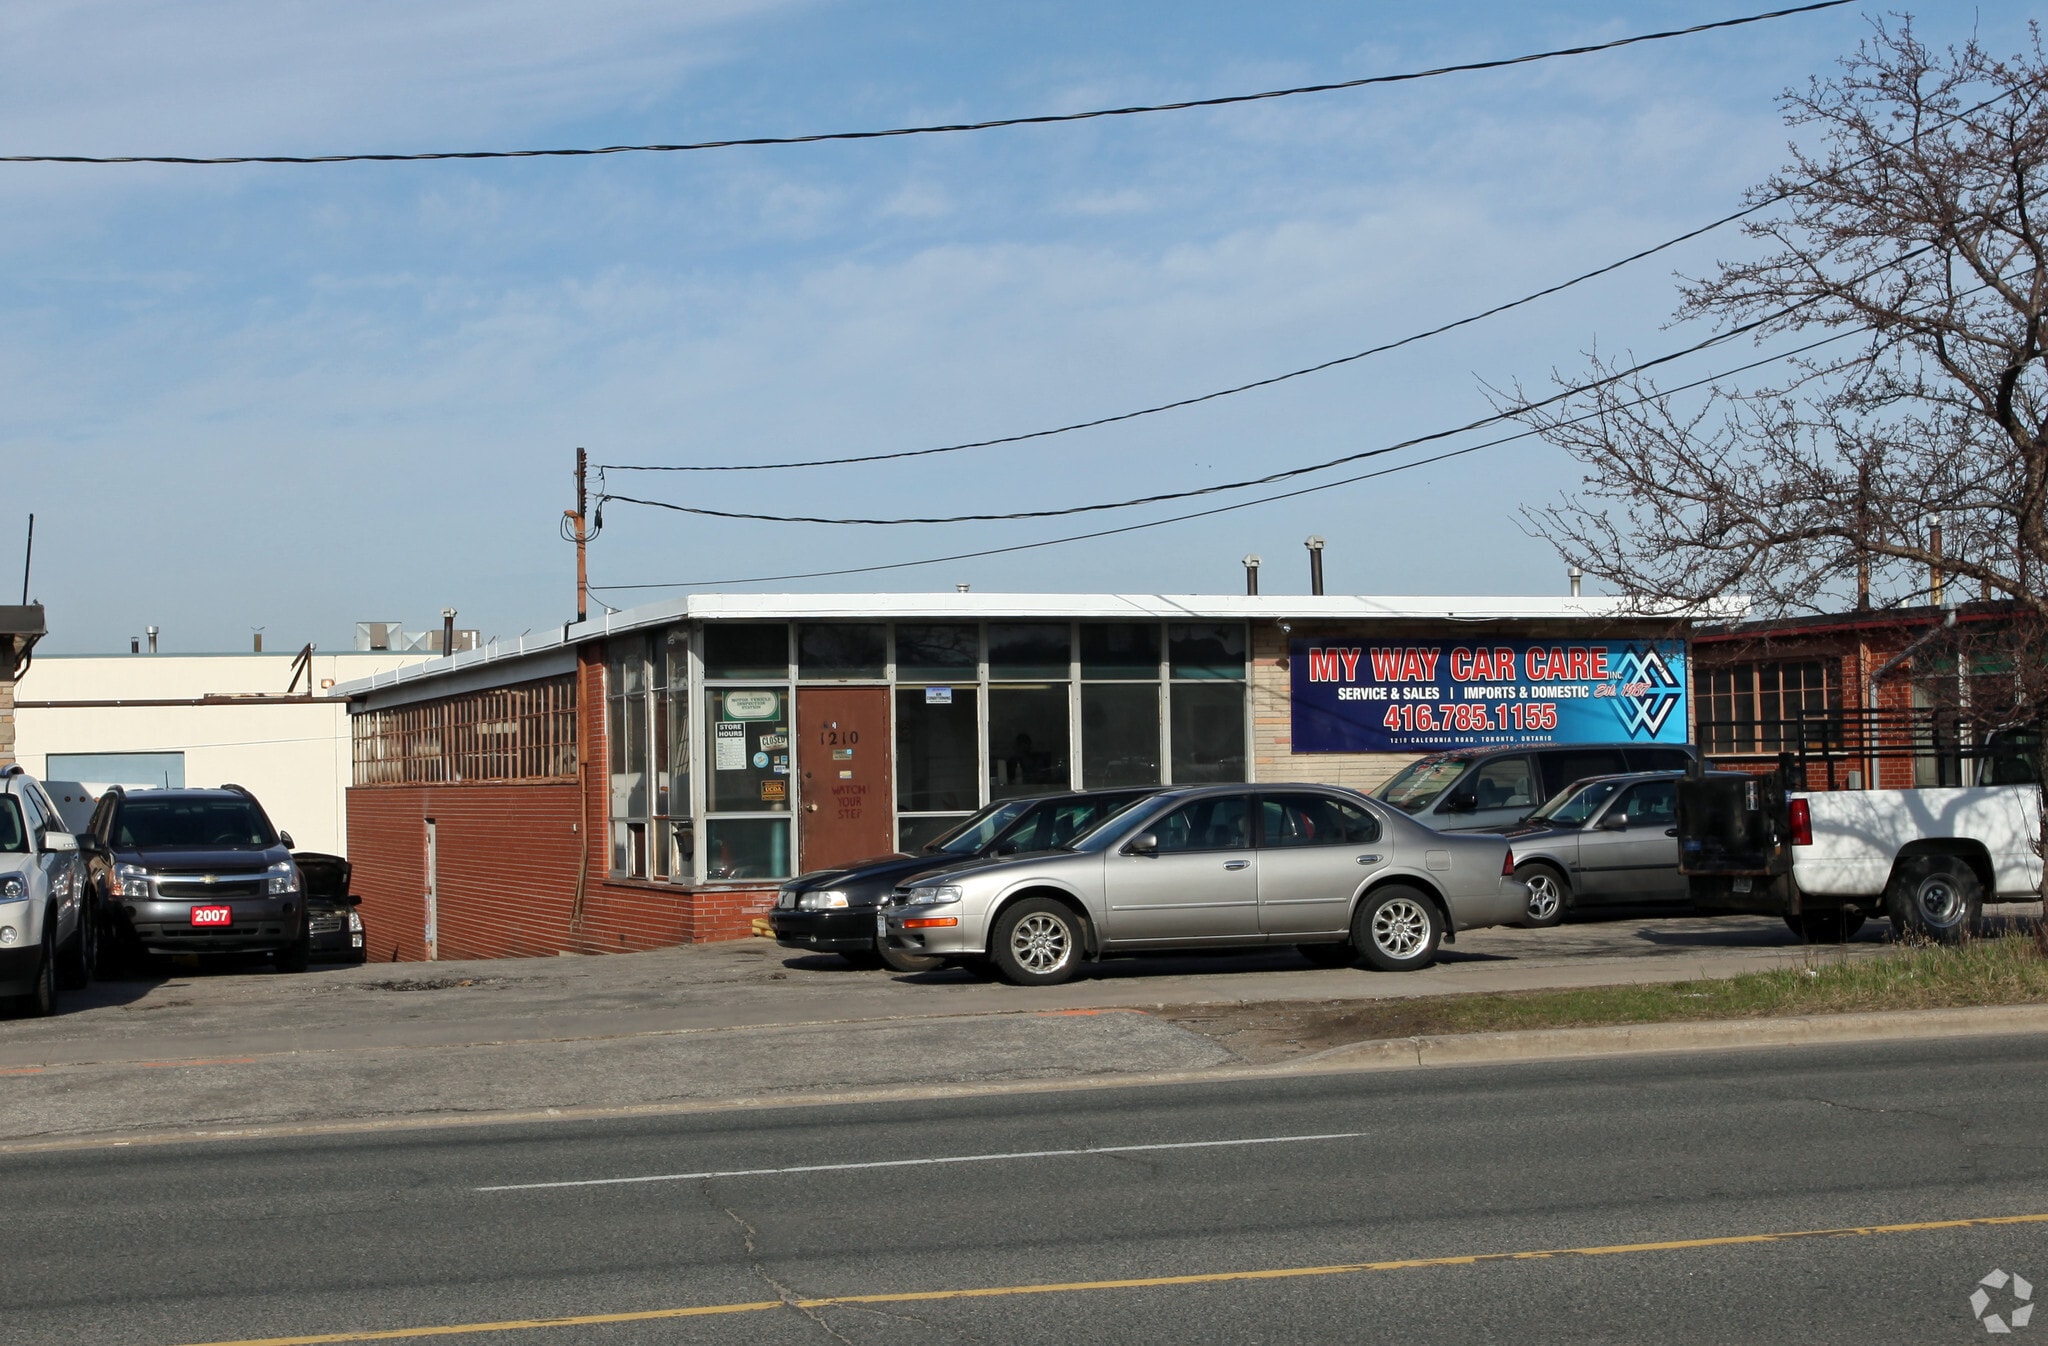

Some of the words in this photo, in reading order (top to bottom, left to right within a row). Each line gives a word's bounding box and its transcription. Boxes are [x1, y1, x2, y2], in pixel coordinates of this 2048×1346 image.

[1309, 647, 1361, 682] MY
[1370, 647, 1441, 682] WAY
[1451, 646, 1516, 681] CAR
[1525, 646, 1609, 681] CARE
[1609, 671, 1624, 680] INC.
[1338, 687, 1387, 700] SERVICE
[1390, 687, 1400, 700] &
[1403, 687, 1440, 700] SALES
[1464, 686, 1516, 699] IMPORTS
[1519, 686, 1528, 698] &
[1531, 685, 1589, 698] DOMESTIC
[1621, 682, 1652, 697] 1987
[1383, 702, 1557, 732] 416.785.1155
[761, 735, 786, 746] CLOSED
[820, 730, 859, 746] 1210
[1411, 736, 1452, 744] CALEDONIA
[836, 796, 862, 808] YOUR
[837, 808, 863, 820] STEP
[195, 909, 228, 922] 2007
